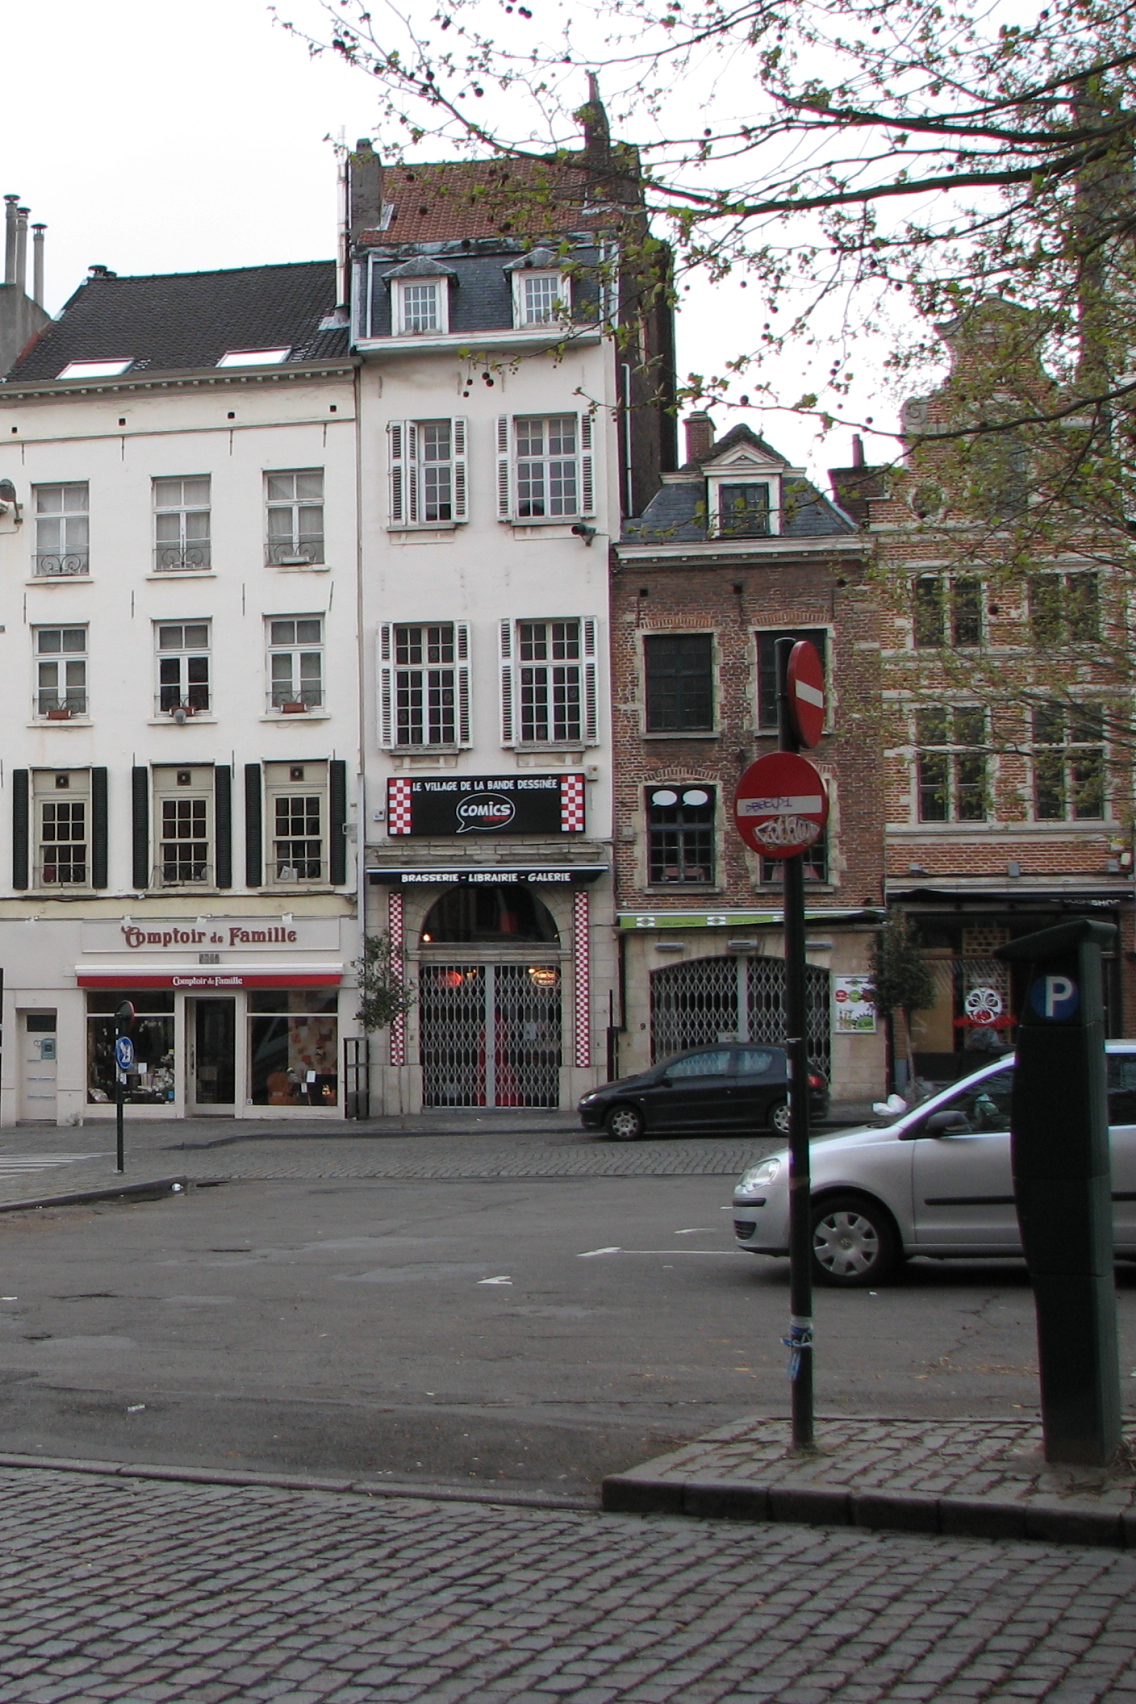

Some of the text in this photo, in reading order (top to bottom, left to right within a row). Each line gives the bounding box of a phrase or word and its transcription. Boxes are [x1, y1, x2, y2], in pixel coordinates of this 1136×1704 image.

[412, 782, 422, 792] LE
[425, 781, 458, 792] VILLAGE
[460, 781, 472, 791] DE
[474, 780, 485, 791] LA
[487, 779, 515, 790] BANDE
[460, 801, 511, 817] COMICS
[401, 873, 459, 883] BRASSERIE
[468, 872, 518, 882] LIBRAIRIE
[527, 872, 571, 882] GALERIE
[121, 925, 297, 948] Comptoir de Famille
[172, 976, 207, 987] Comptoir
[215, 976, 243, 987] Famille
[1045, 975, 1073, 1017] P
